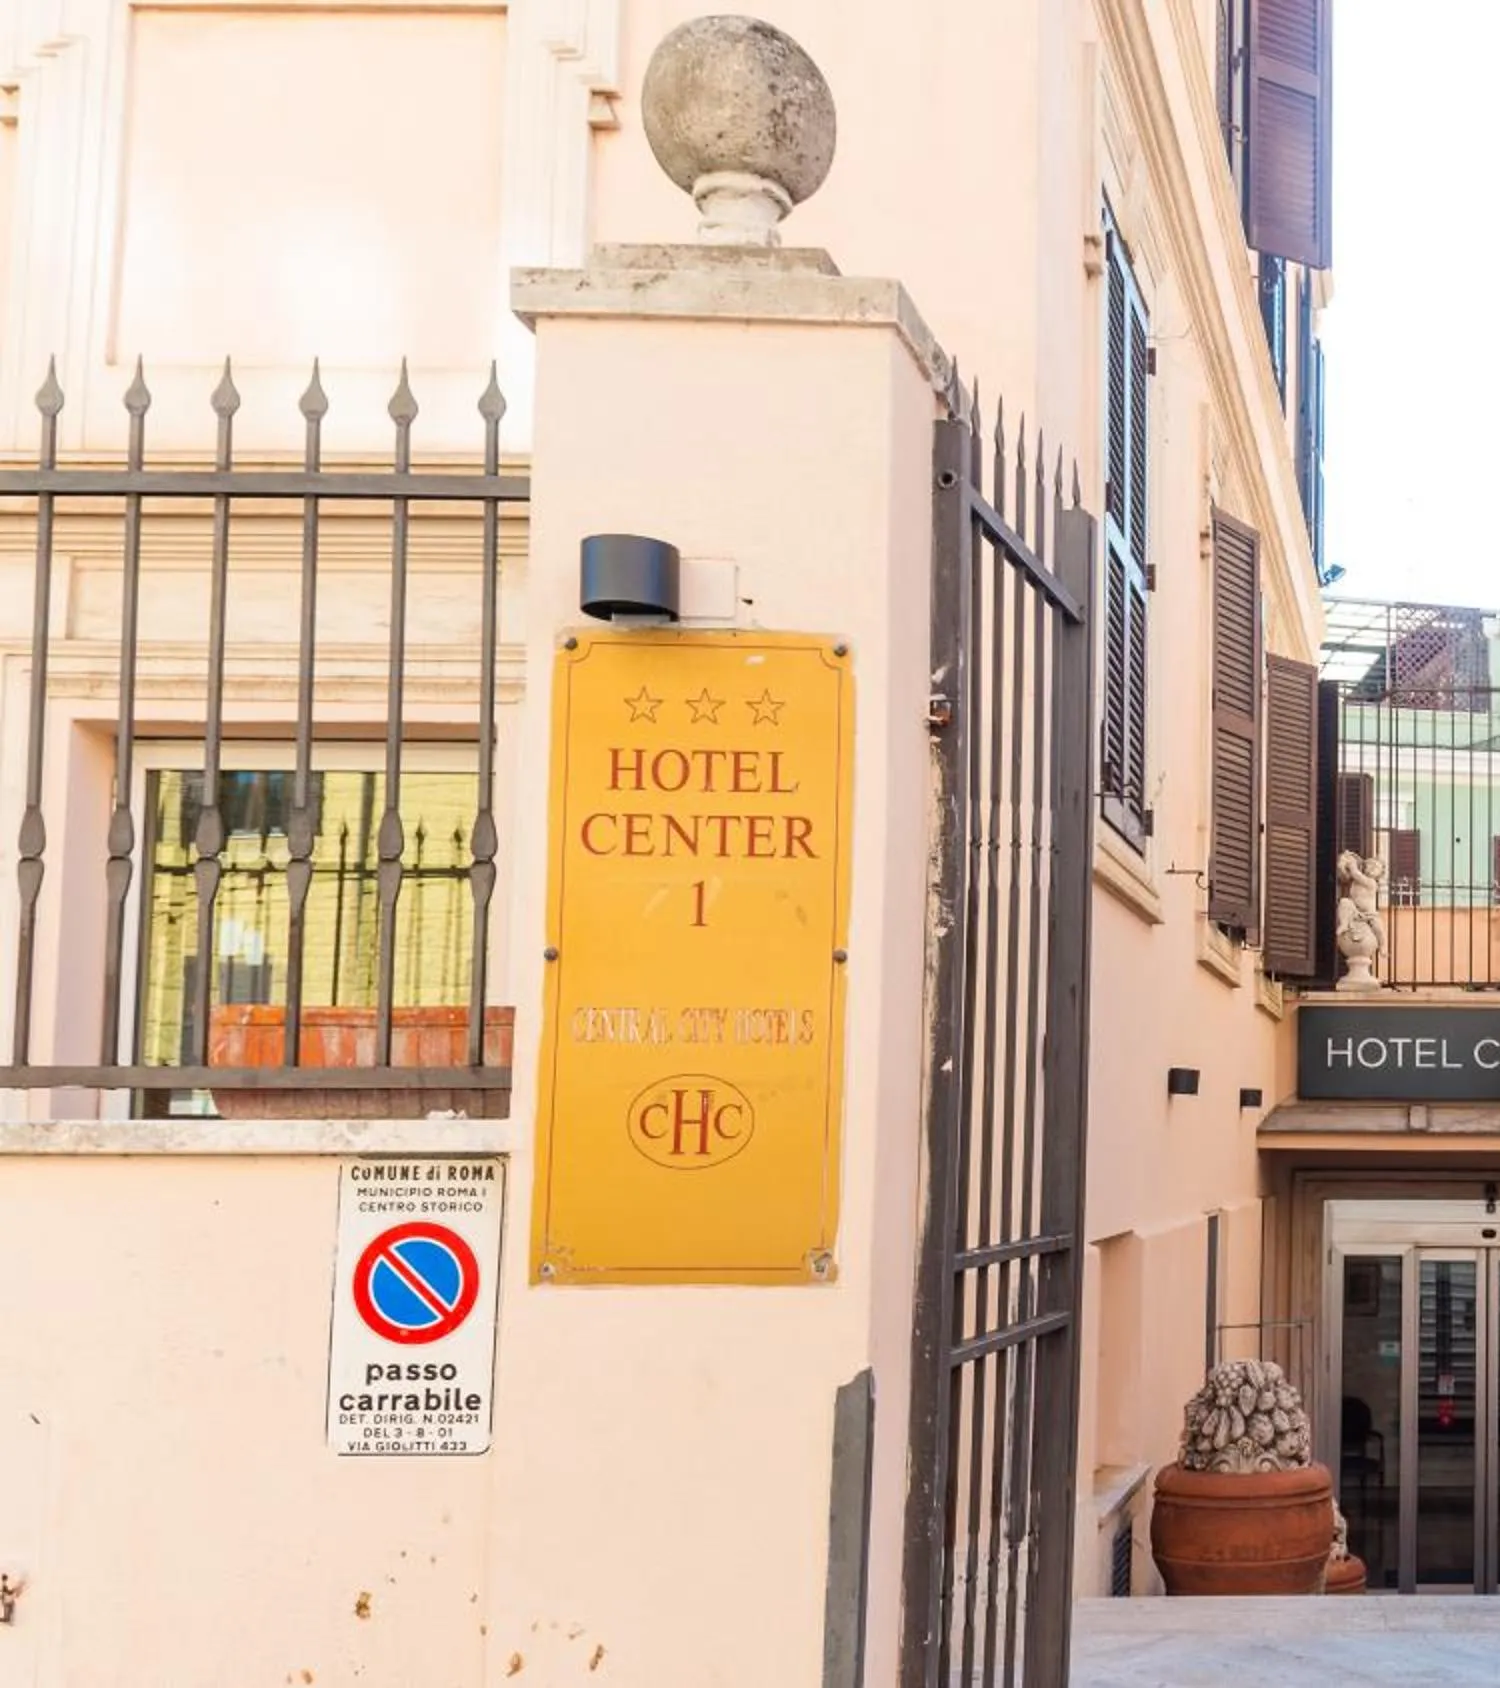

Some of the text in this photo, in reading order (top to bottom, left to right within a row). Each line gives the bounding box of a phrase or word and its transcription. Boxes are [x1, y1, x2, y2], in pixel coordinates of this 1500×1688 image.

[606, 748, 800, 793] HOTEL
[580, 813, 820, 859] CENTER
[689, 880, 708, 927] 1
[573, 1007, 814, 1045] CENTRAL CITY HOTELS
[1326, 1038, 1463, 1069] HOTEL
[426, 1165, 441, 1181] di
[448, 1165, 495, 1181] ROMA
[357, 1187, 432, 1197] MUNICIPIO
[437, 1187, 477, 1197] ROMA
[359, 1201, 483, 1213] CENTRO STORICO
[365, 1363, 458, 1386] passo
[339, 1387, 482, 1411] carrabile
[339, 1413, 369, 1425] DET.
[363, 1427, 390, 1438] DEL
[347, 1441, 370, 1451] VIA
[376, 1441, 435, 1451] GIOLITTI
